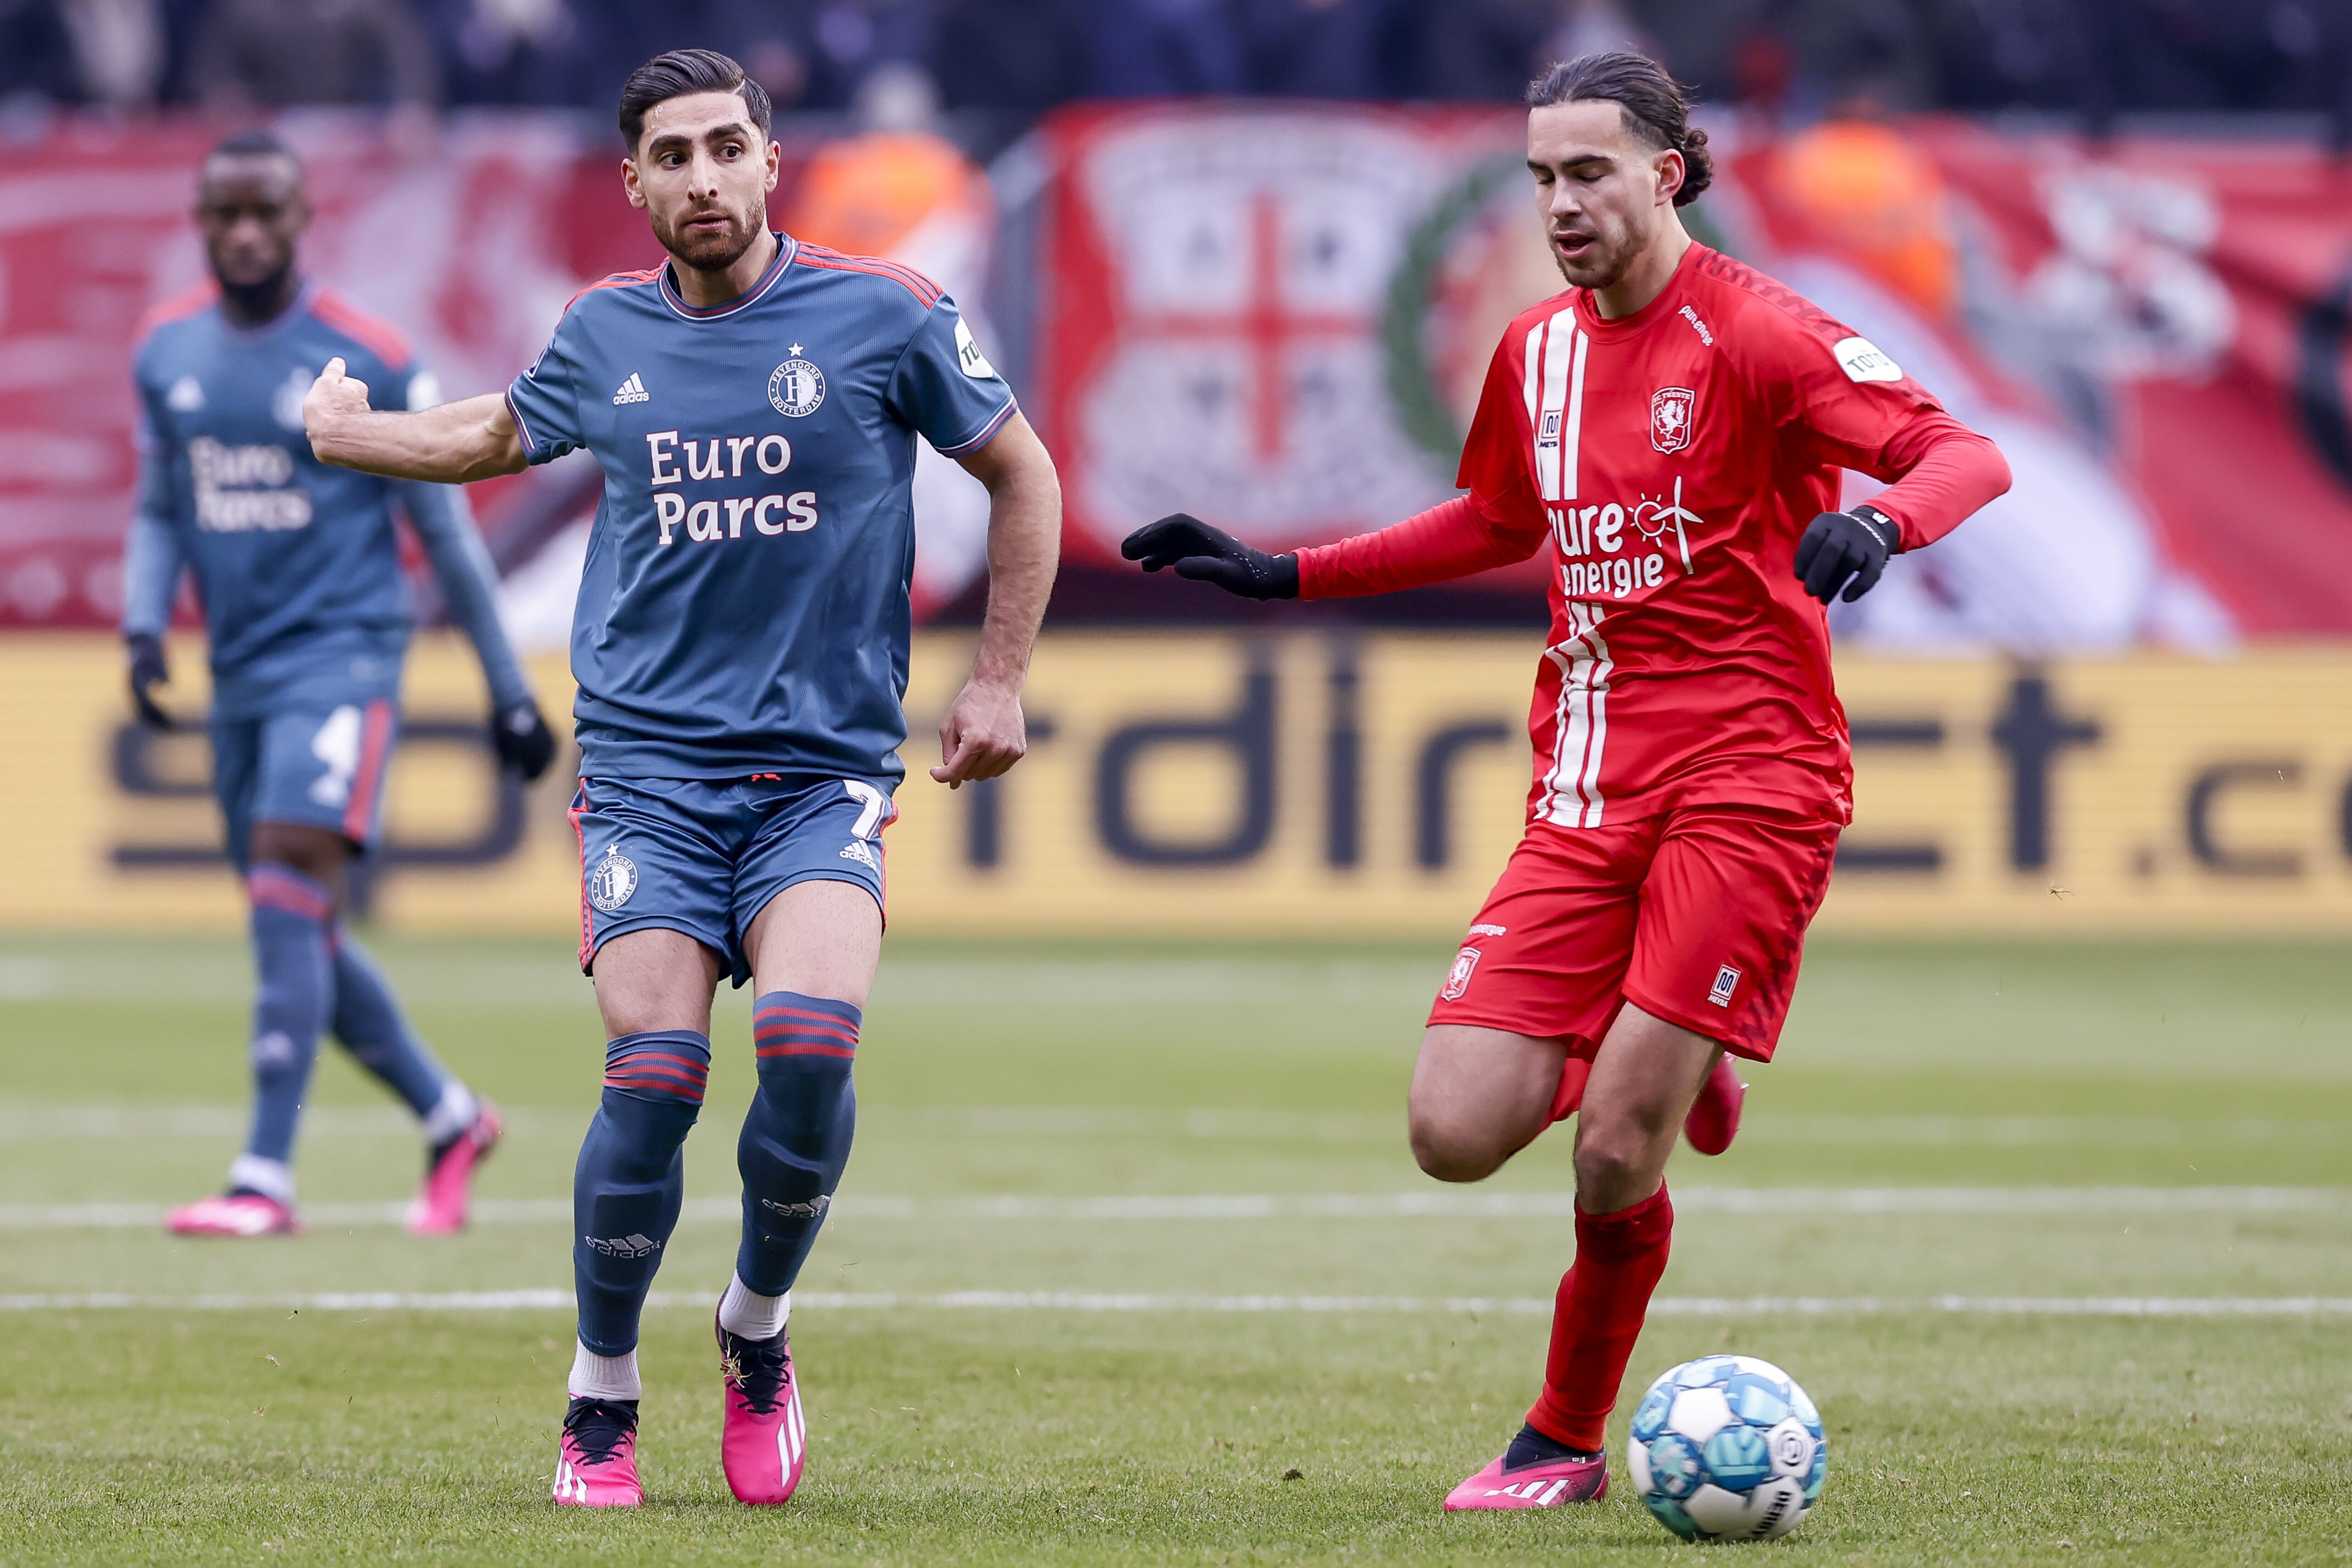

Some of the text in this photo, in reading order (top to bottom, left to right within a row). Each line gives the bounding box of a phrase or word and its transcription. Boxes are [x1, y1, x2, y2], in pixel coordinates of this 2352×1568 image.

[961, 340, 980, 366] TO
[1846, 353, 1889, 373] TOTO
[772, 362, 820, 382] FEYENOORD
[613, 392, 650, 405] adidas
[784, 374, 807, 402] F
[772, 394, 821, 414] ROTTERDAM
[646, 430, 791, 486] Euro
[653, 491, 818, 546] Parcs
[312, 704, 362, 807] 4
[842, 779, 886, 841] 7
[594, 858, 633, 883] FEYENOORD
[596, 883, 634, 908] ROTTERDAM
